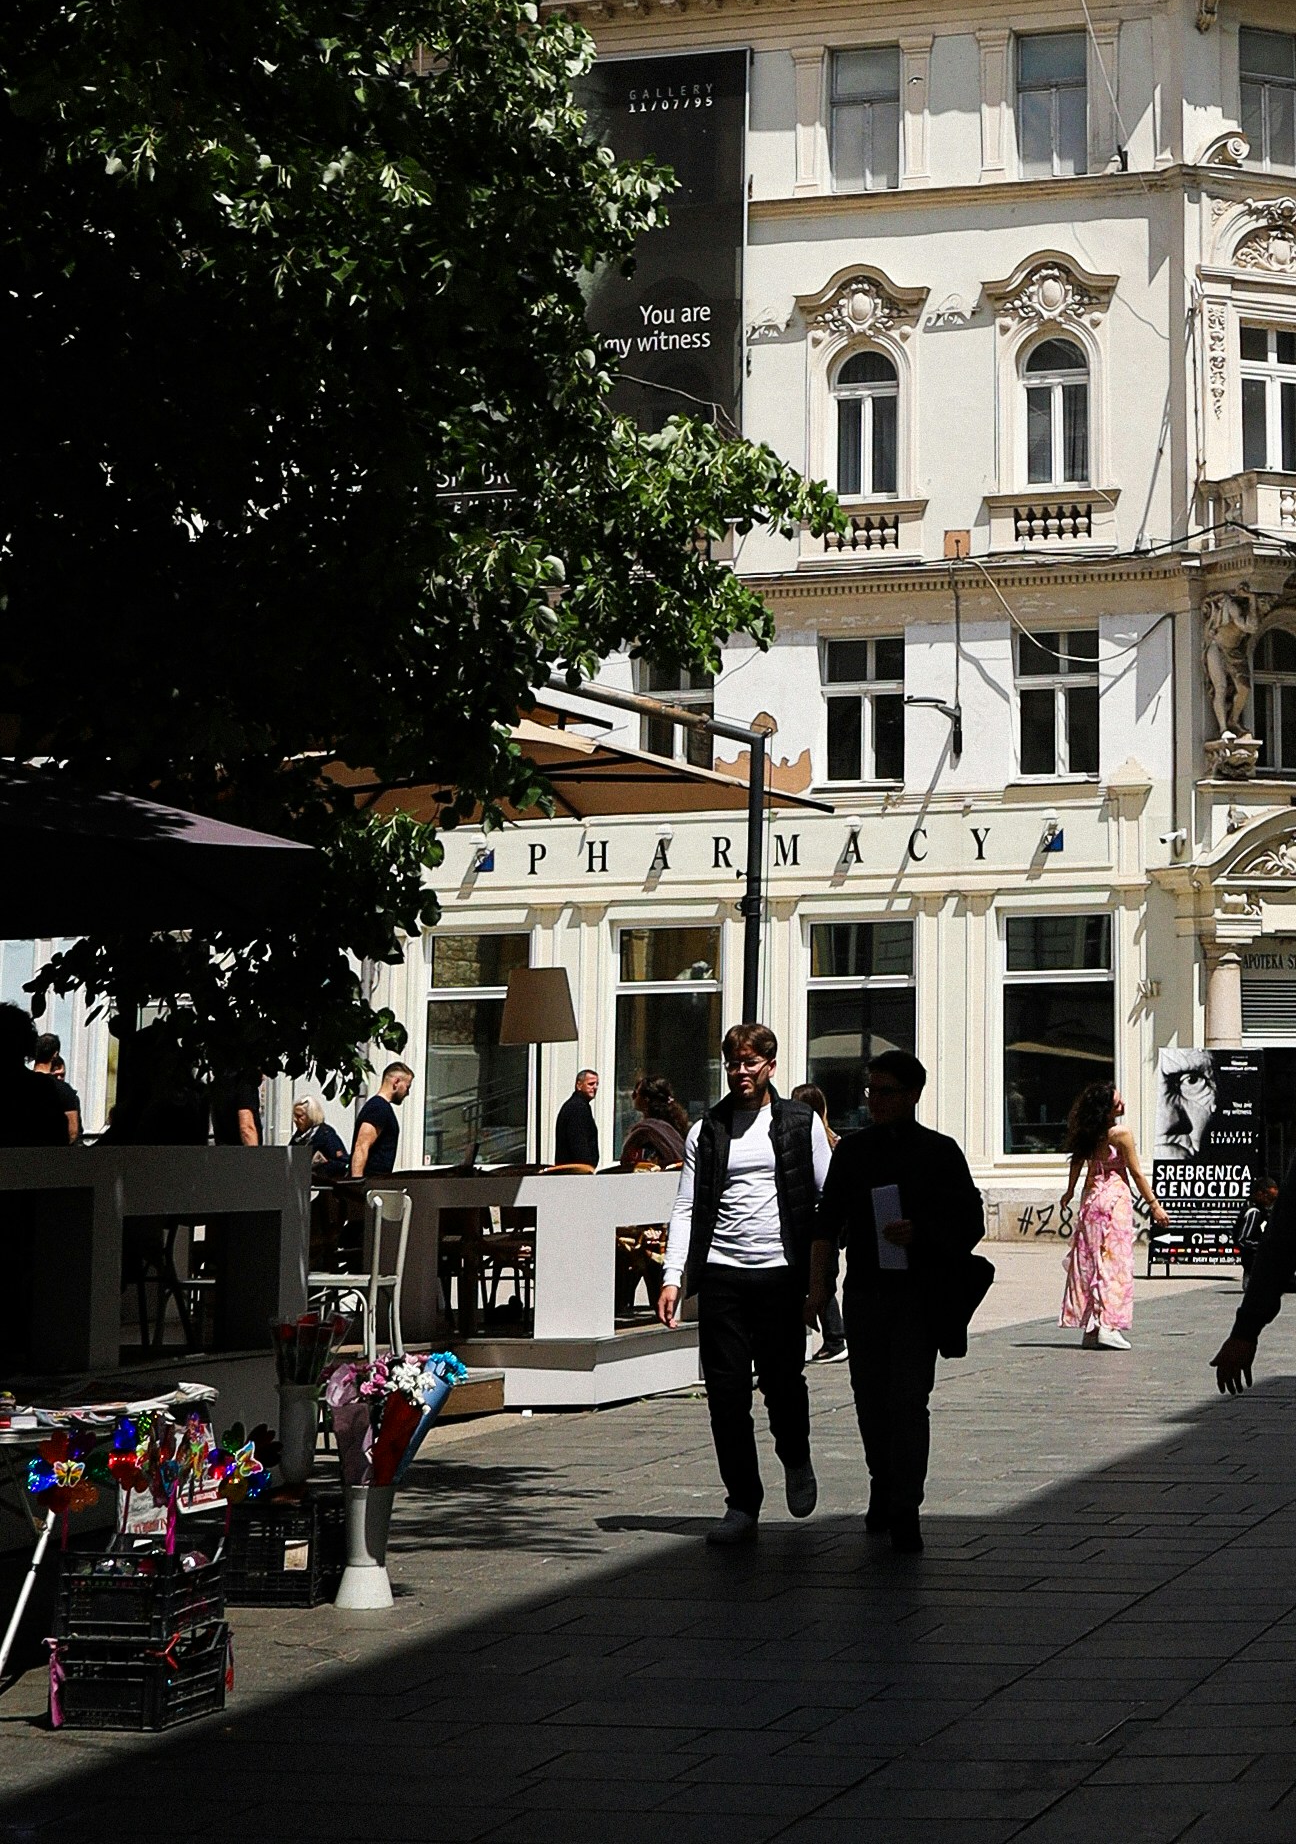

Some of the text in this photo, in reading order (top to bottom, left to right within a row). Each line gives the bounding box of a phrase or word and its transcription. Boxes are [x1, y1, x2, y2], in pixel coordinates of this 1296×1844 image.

[629, 83, 714, 101] GALLERY
[628, 97, 714, 113] 11/07/95
[639, 304, 712, 326] You are
[604, 330, 711, 359] my witness
[528, 827, 992, 875] PHARMACY
[1244, 953, 1283, 970] APOTEKA
[1210, 1130, 1253, 1138] GALLERY
[1156, 1164, 1251, 1181] SREBRENICA
[1155, 1181, 1251, 1197] GENOCIDE
